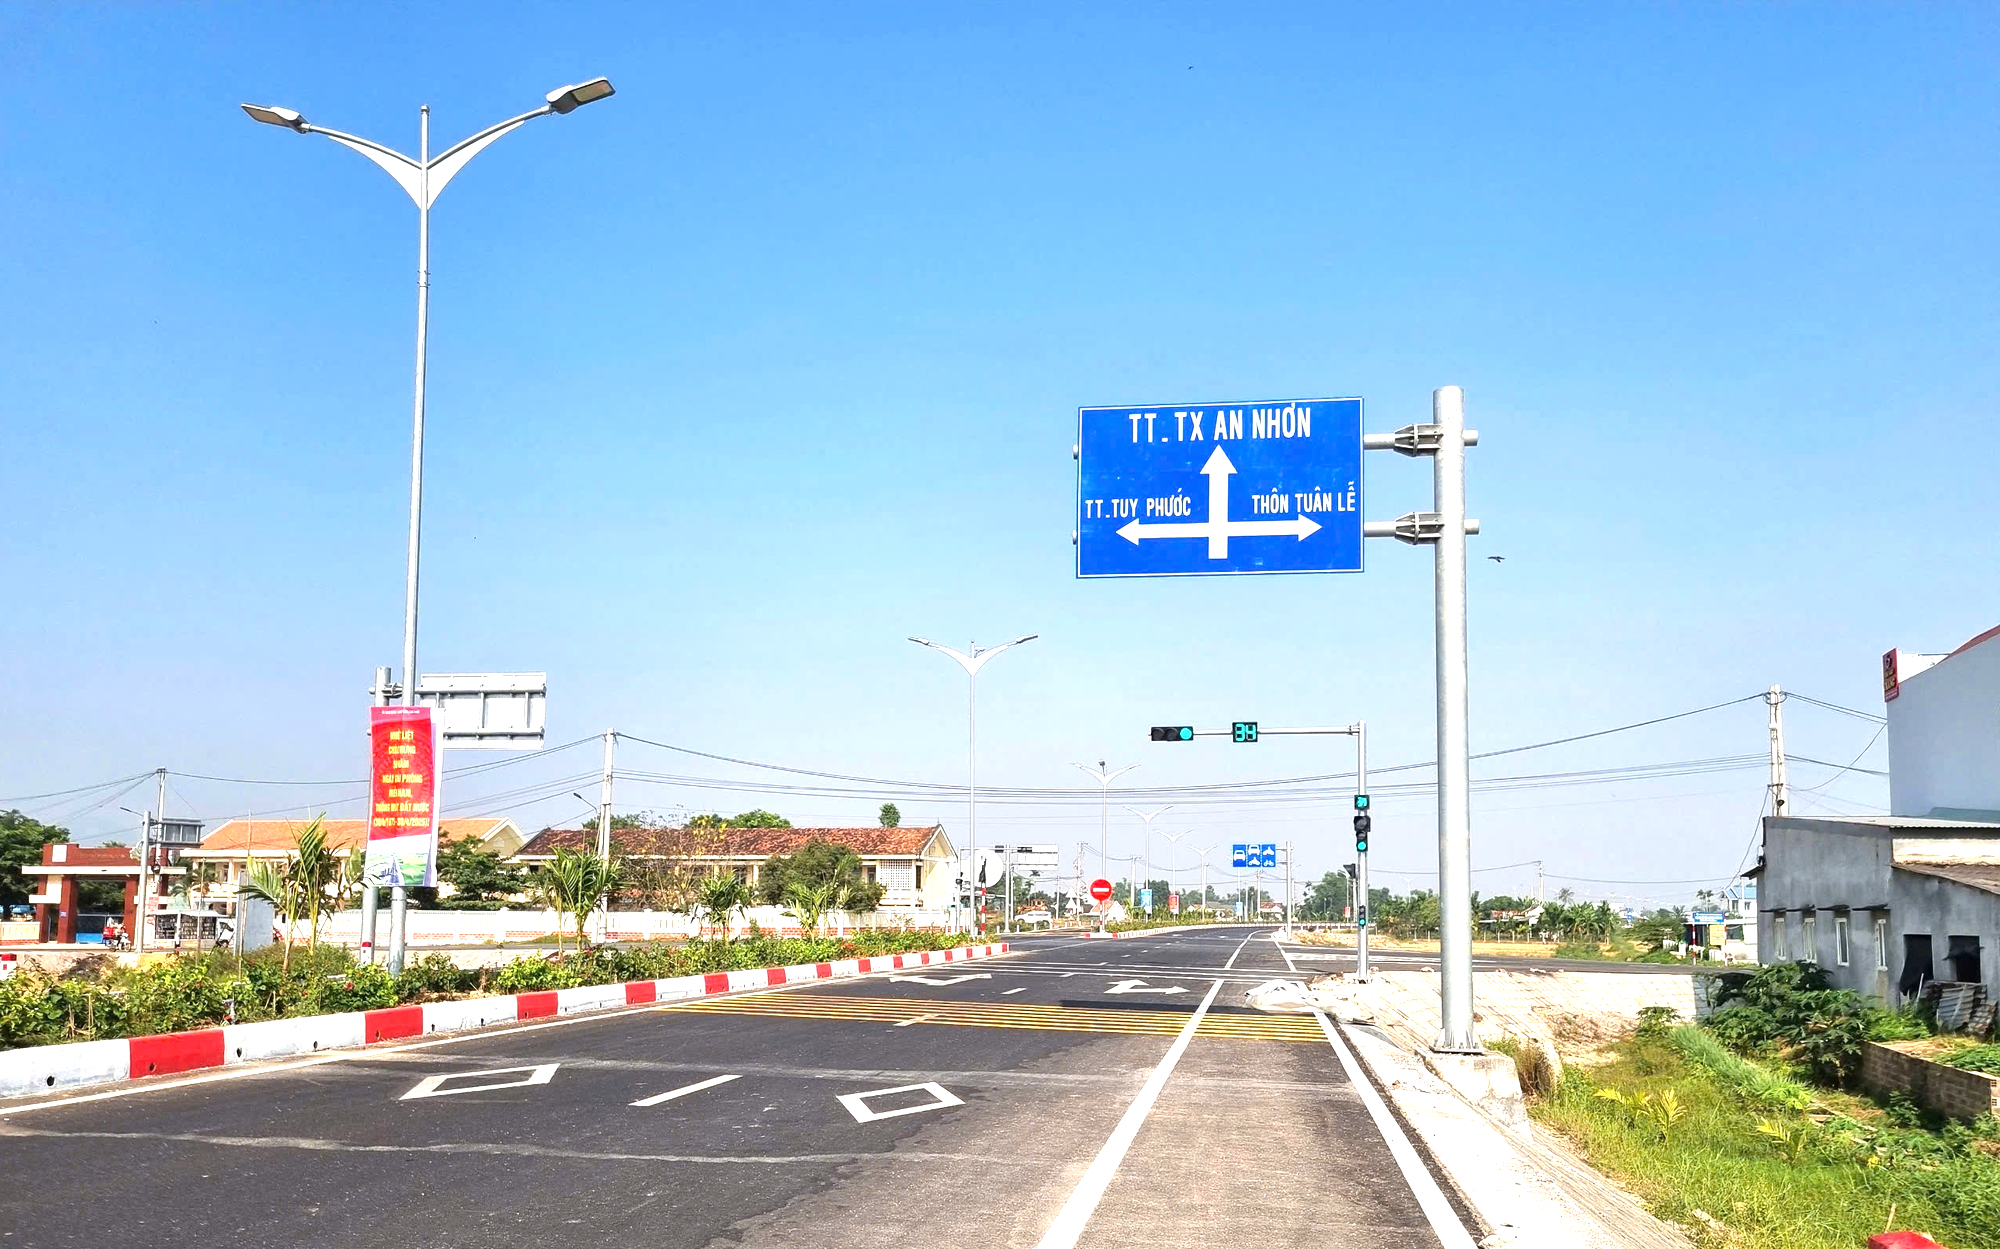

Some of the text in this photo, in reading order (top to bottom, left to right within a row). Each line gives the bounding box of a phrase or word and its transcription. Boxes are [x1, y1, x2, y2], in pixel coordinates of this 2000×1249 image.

[1213, 409, 1243, 440] AN
[1252, 402, 1311, 439] NHƠN
[1146, 487, 1192, 518] PHƯỚC
[1251, 480, 1356, 514] THÔN TUÂN LỄ
[1235, 724, 1257, 742] 34
